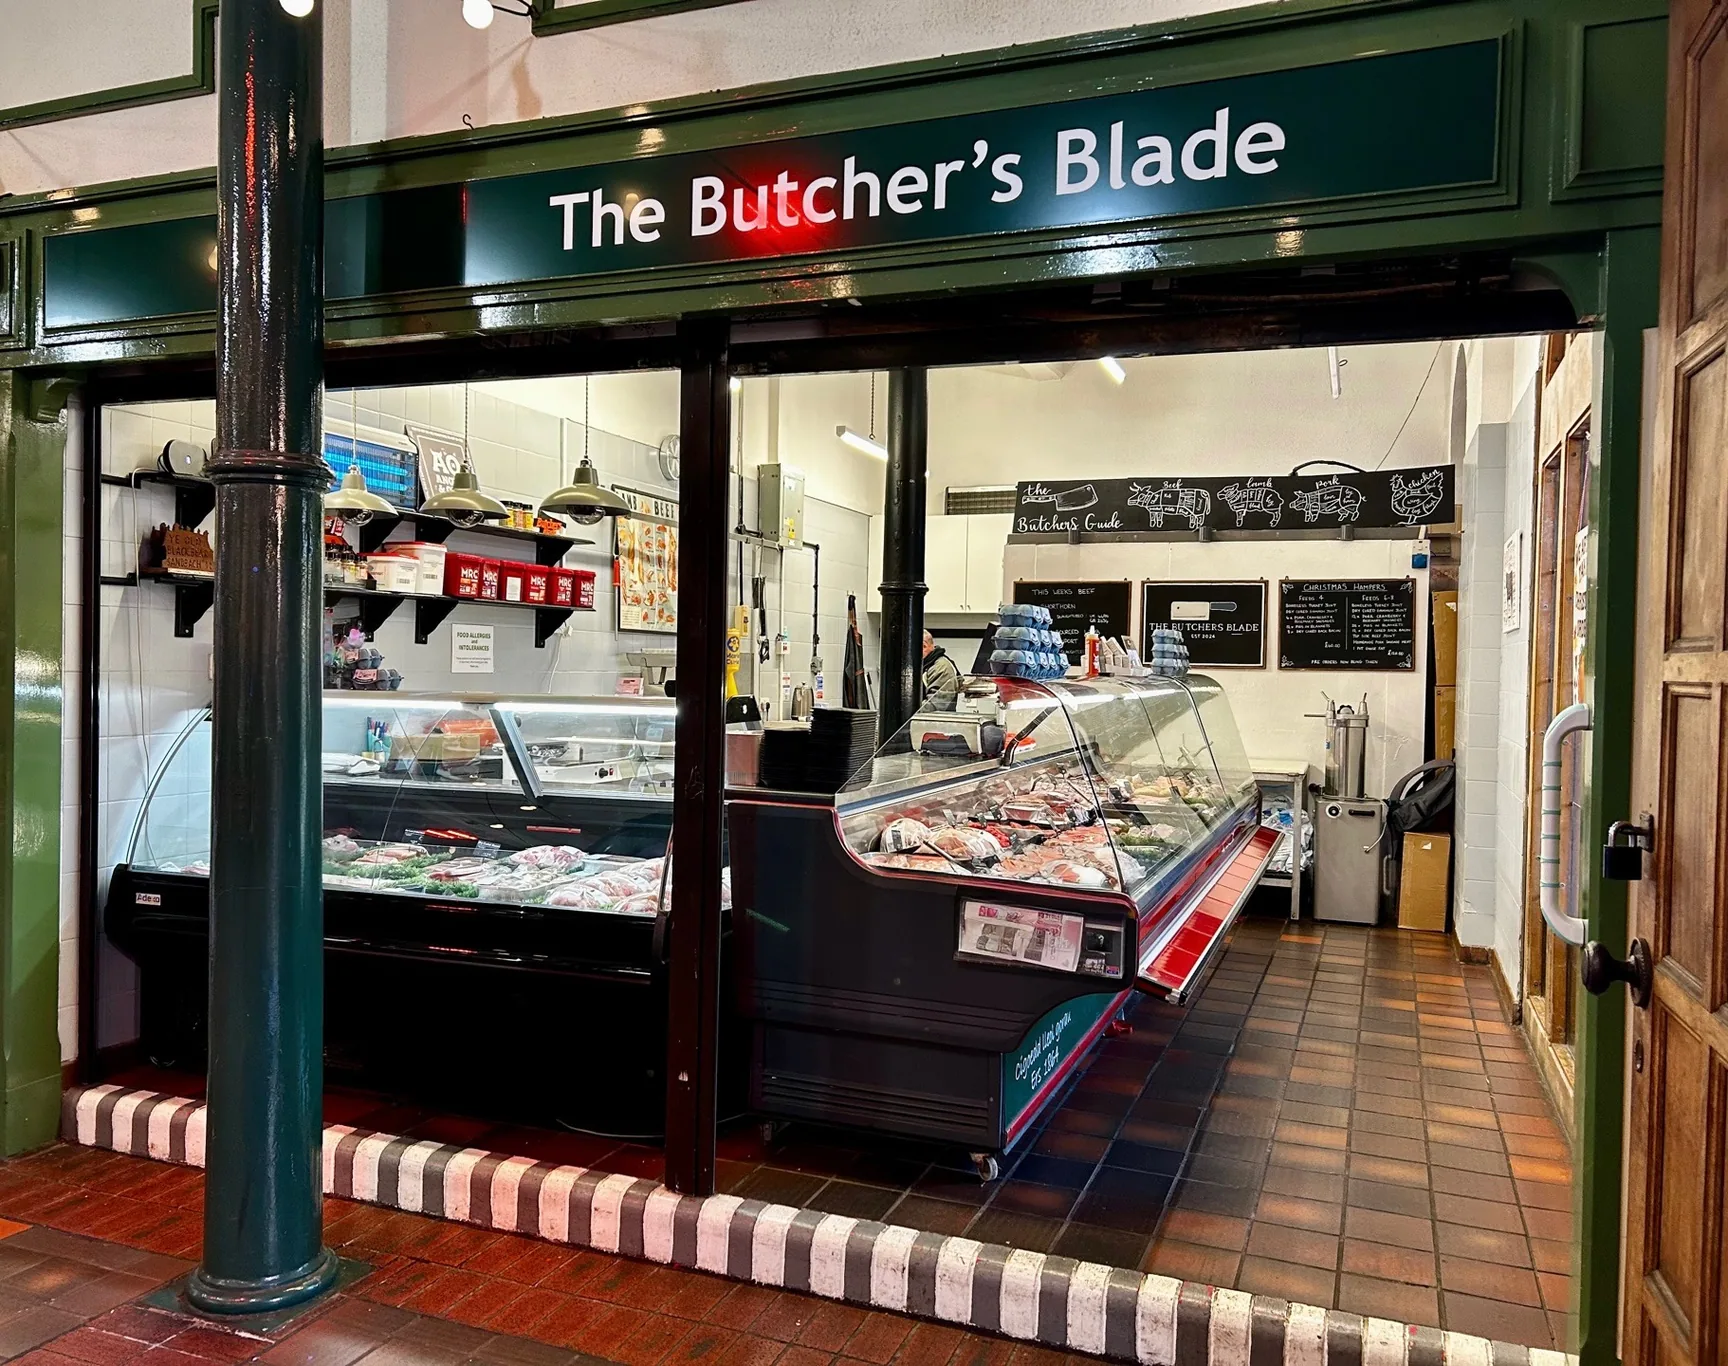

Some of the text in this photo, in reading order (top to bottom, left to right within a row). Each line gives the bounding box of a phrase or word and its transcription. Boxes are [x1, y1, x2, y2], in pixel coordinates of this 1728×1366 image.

[550, 106, 1286, 251] The Butcher's Blade
[1023, 482, 1051, 496] the
[1162, 479, 1183, 490] Beef
[654, 501, 674, 518] BEEF
[1017, 512, 1124, 532] Butchers Guide
[461, 567, 479, 578] MRC
[483, 570, 498, 581] MRC
[531, 575, 546, 585] MRC
[558, 576, 572, 587] MRC
[581, 580, 594, 591] MRC
[1149, 623, 1168, 631] THE
[1172, 623, 1223, 631] BUTCHERS
